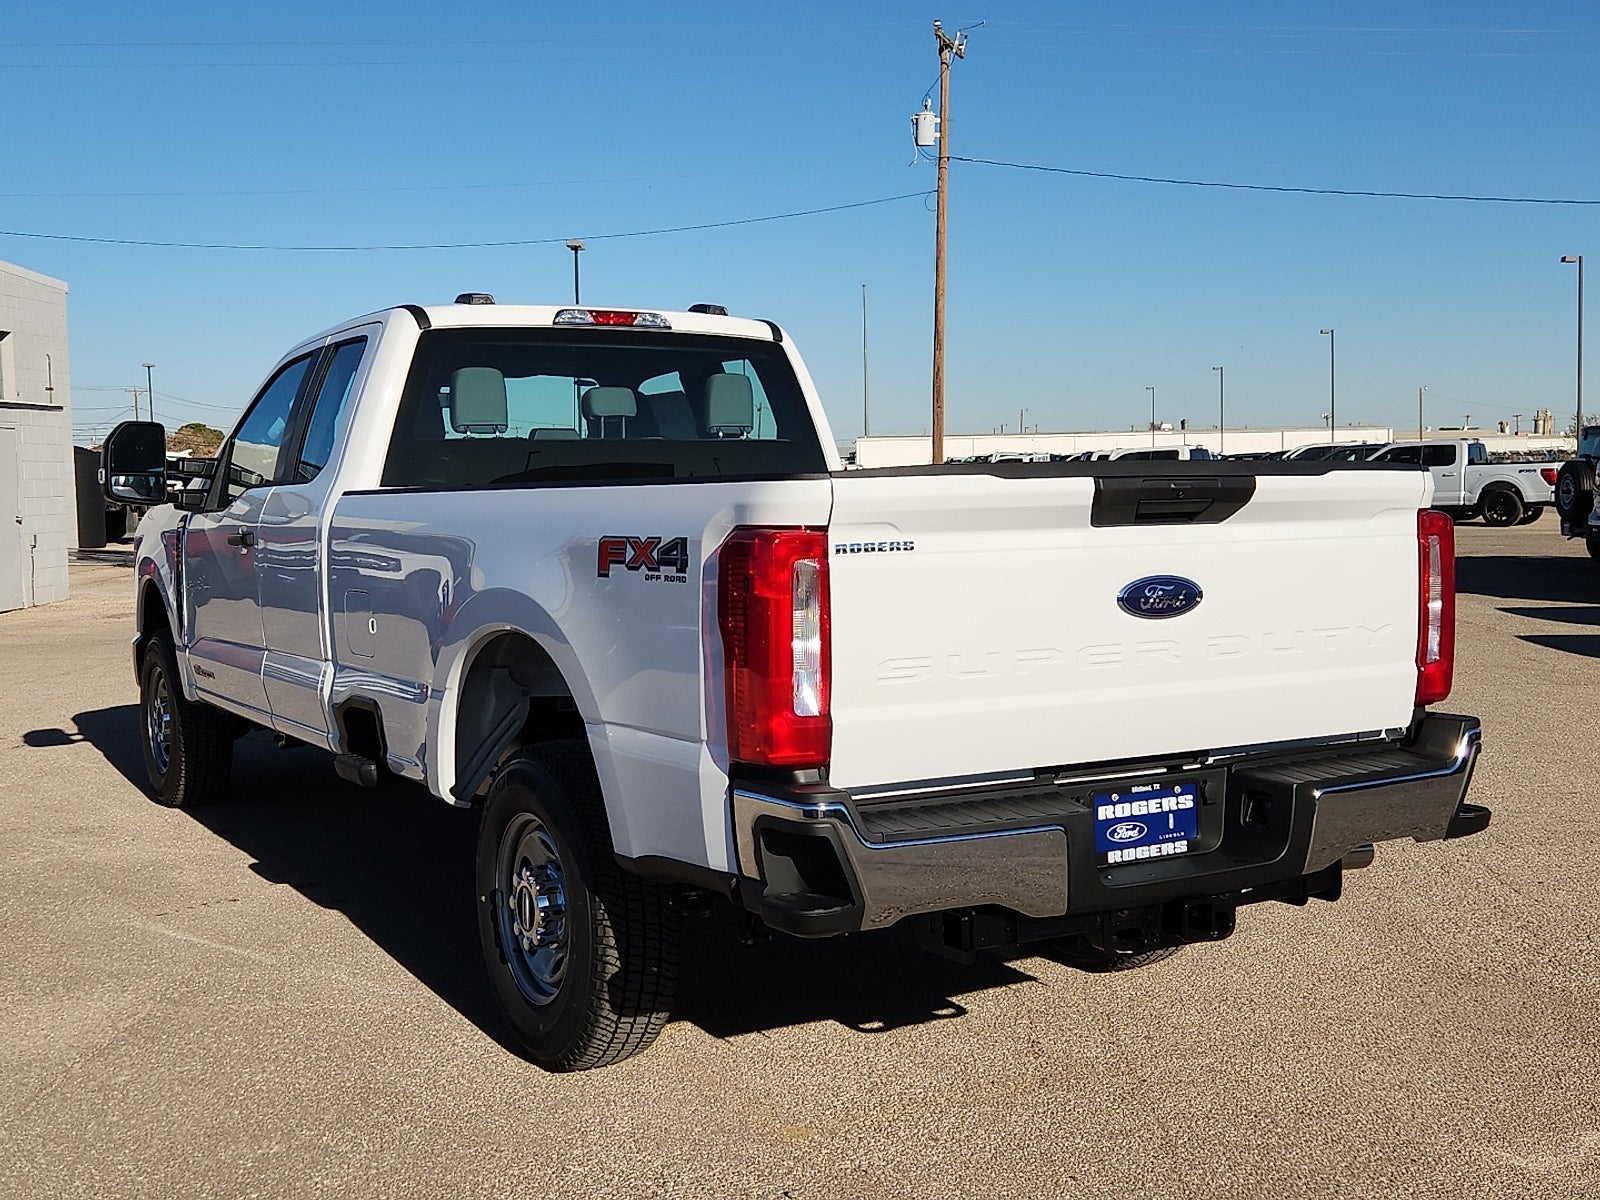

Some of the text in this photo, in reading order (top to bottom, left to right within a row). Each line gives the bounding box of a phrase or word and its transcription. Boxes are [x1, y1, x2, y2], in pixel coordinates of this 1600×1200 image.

[597, 535, 688, 578] FX4
[835, 541, 914, 555] ROGERS
[645, 574, 687, 583] OFF ROAD
[1140, 584, 1186, 609] Ford
[877, 623, 1393, 686] SUPER DUTY
[1098, 795, 1193, 820] ROGERS
[1114, 824, 1140, 839] Ford
[1107, 840, 1187, 863] ROGERS
